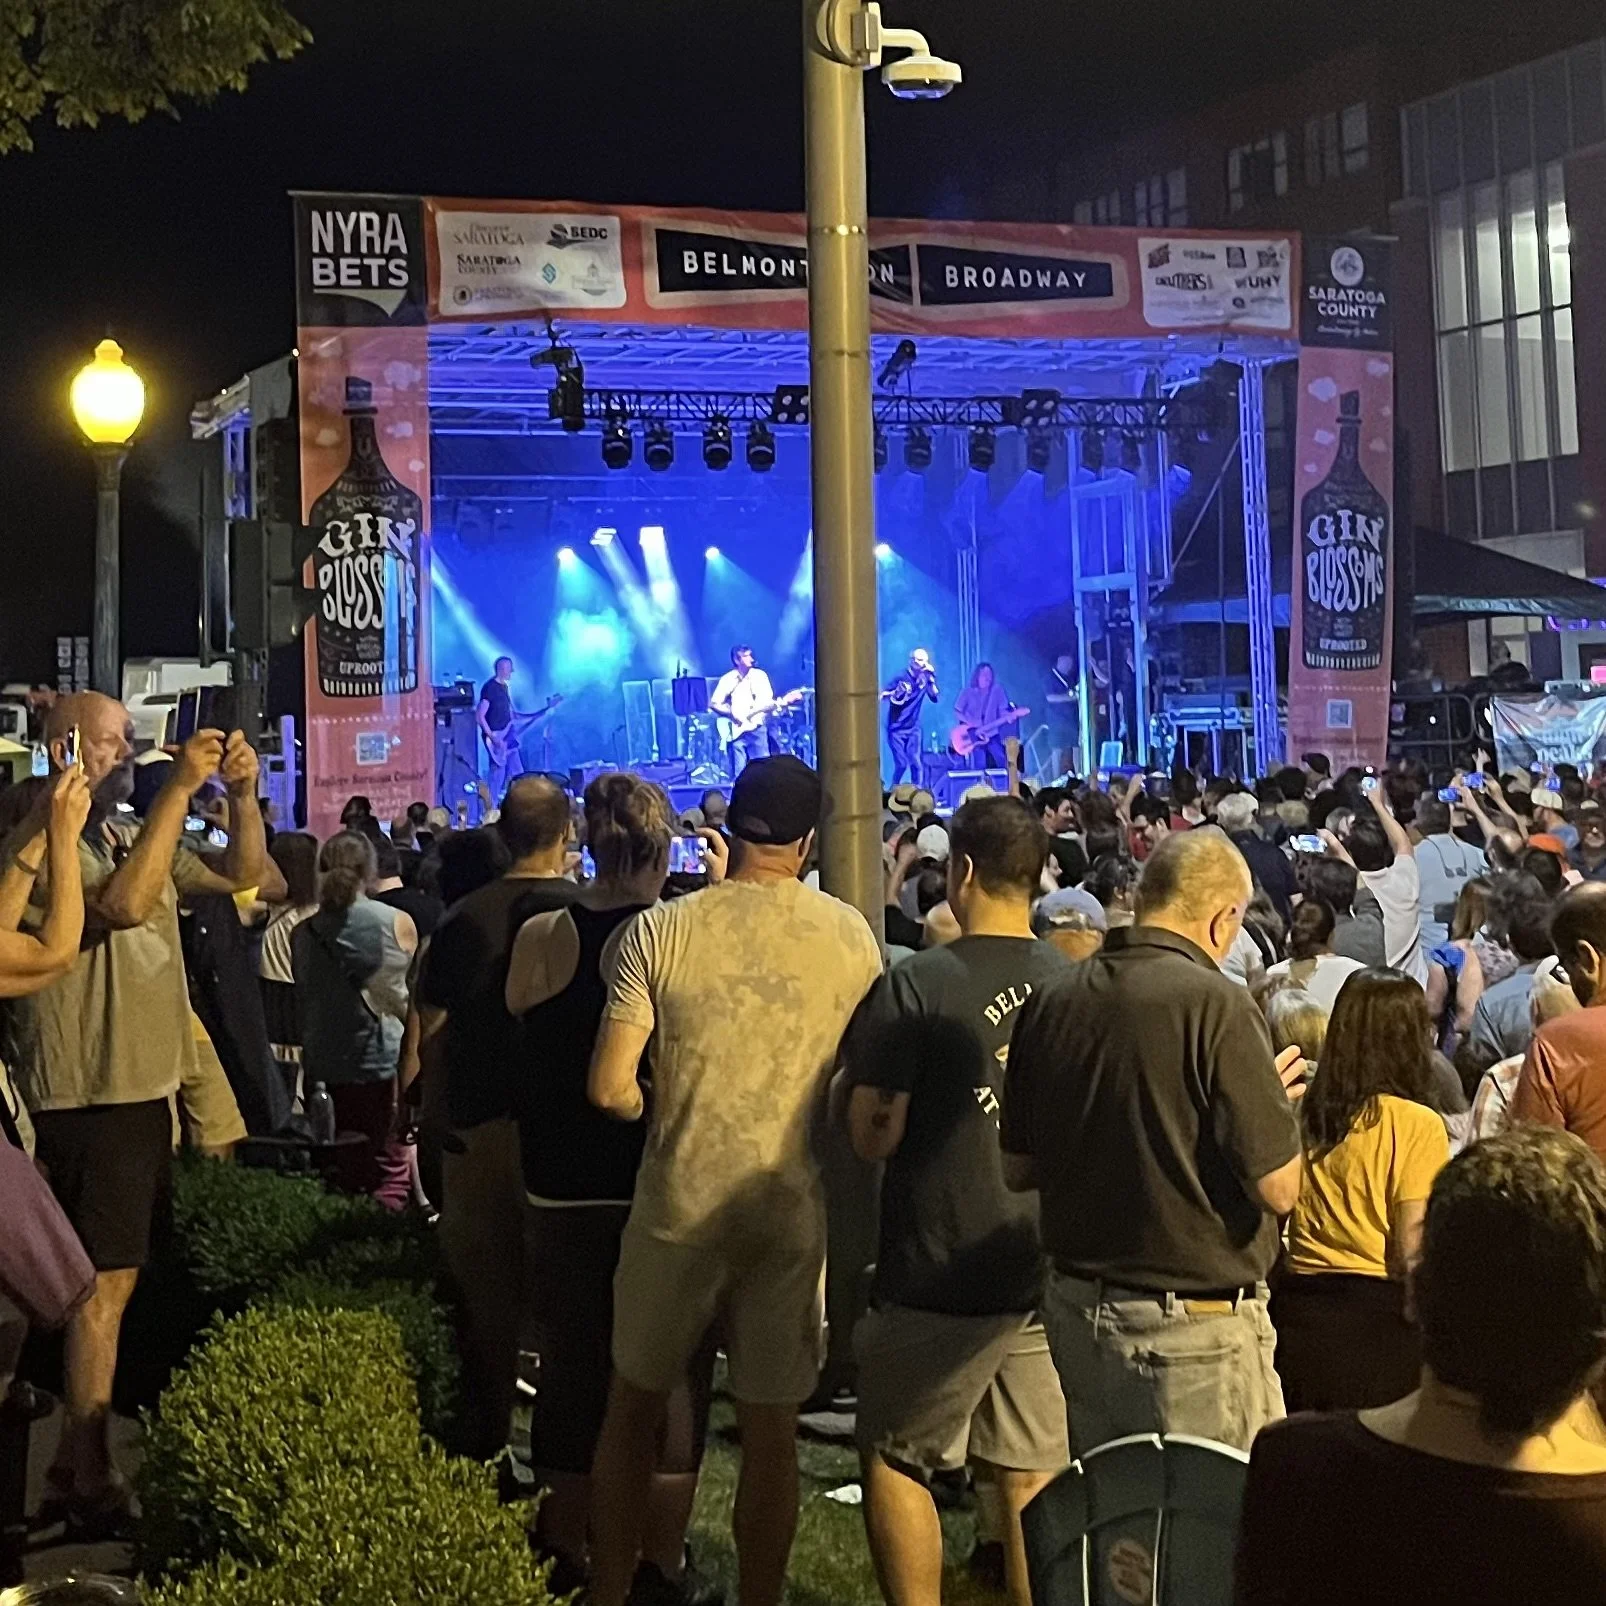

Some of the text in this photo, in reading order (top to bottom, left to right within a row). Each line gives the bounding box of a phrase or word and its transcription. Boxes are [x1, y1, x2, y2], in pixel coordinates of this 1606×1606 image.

[312, 210, 408, 254] NYRA
[312, 258, 409, 287] BETS
[457, 253, 521, 265] SARATOGA
[945, 264, 1087, 289] BROADWAY
[1309, 286, 1386, 304] SARATOGA
[1318, 301, 1377, 318] COUNTY
[318, 513, 415, 560] GIN
[1306, 509, 1385, 552] GIN
[1306, 545, 1384, 612] BLOSSOMS
